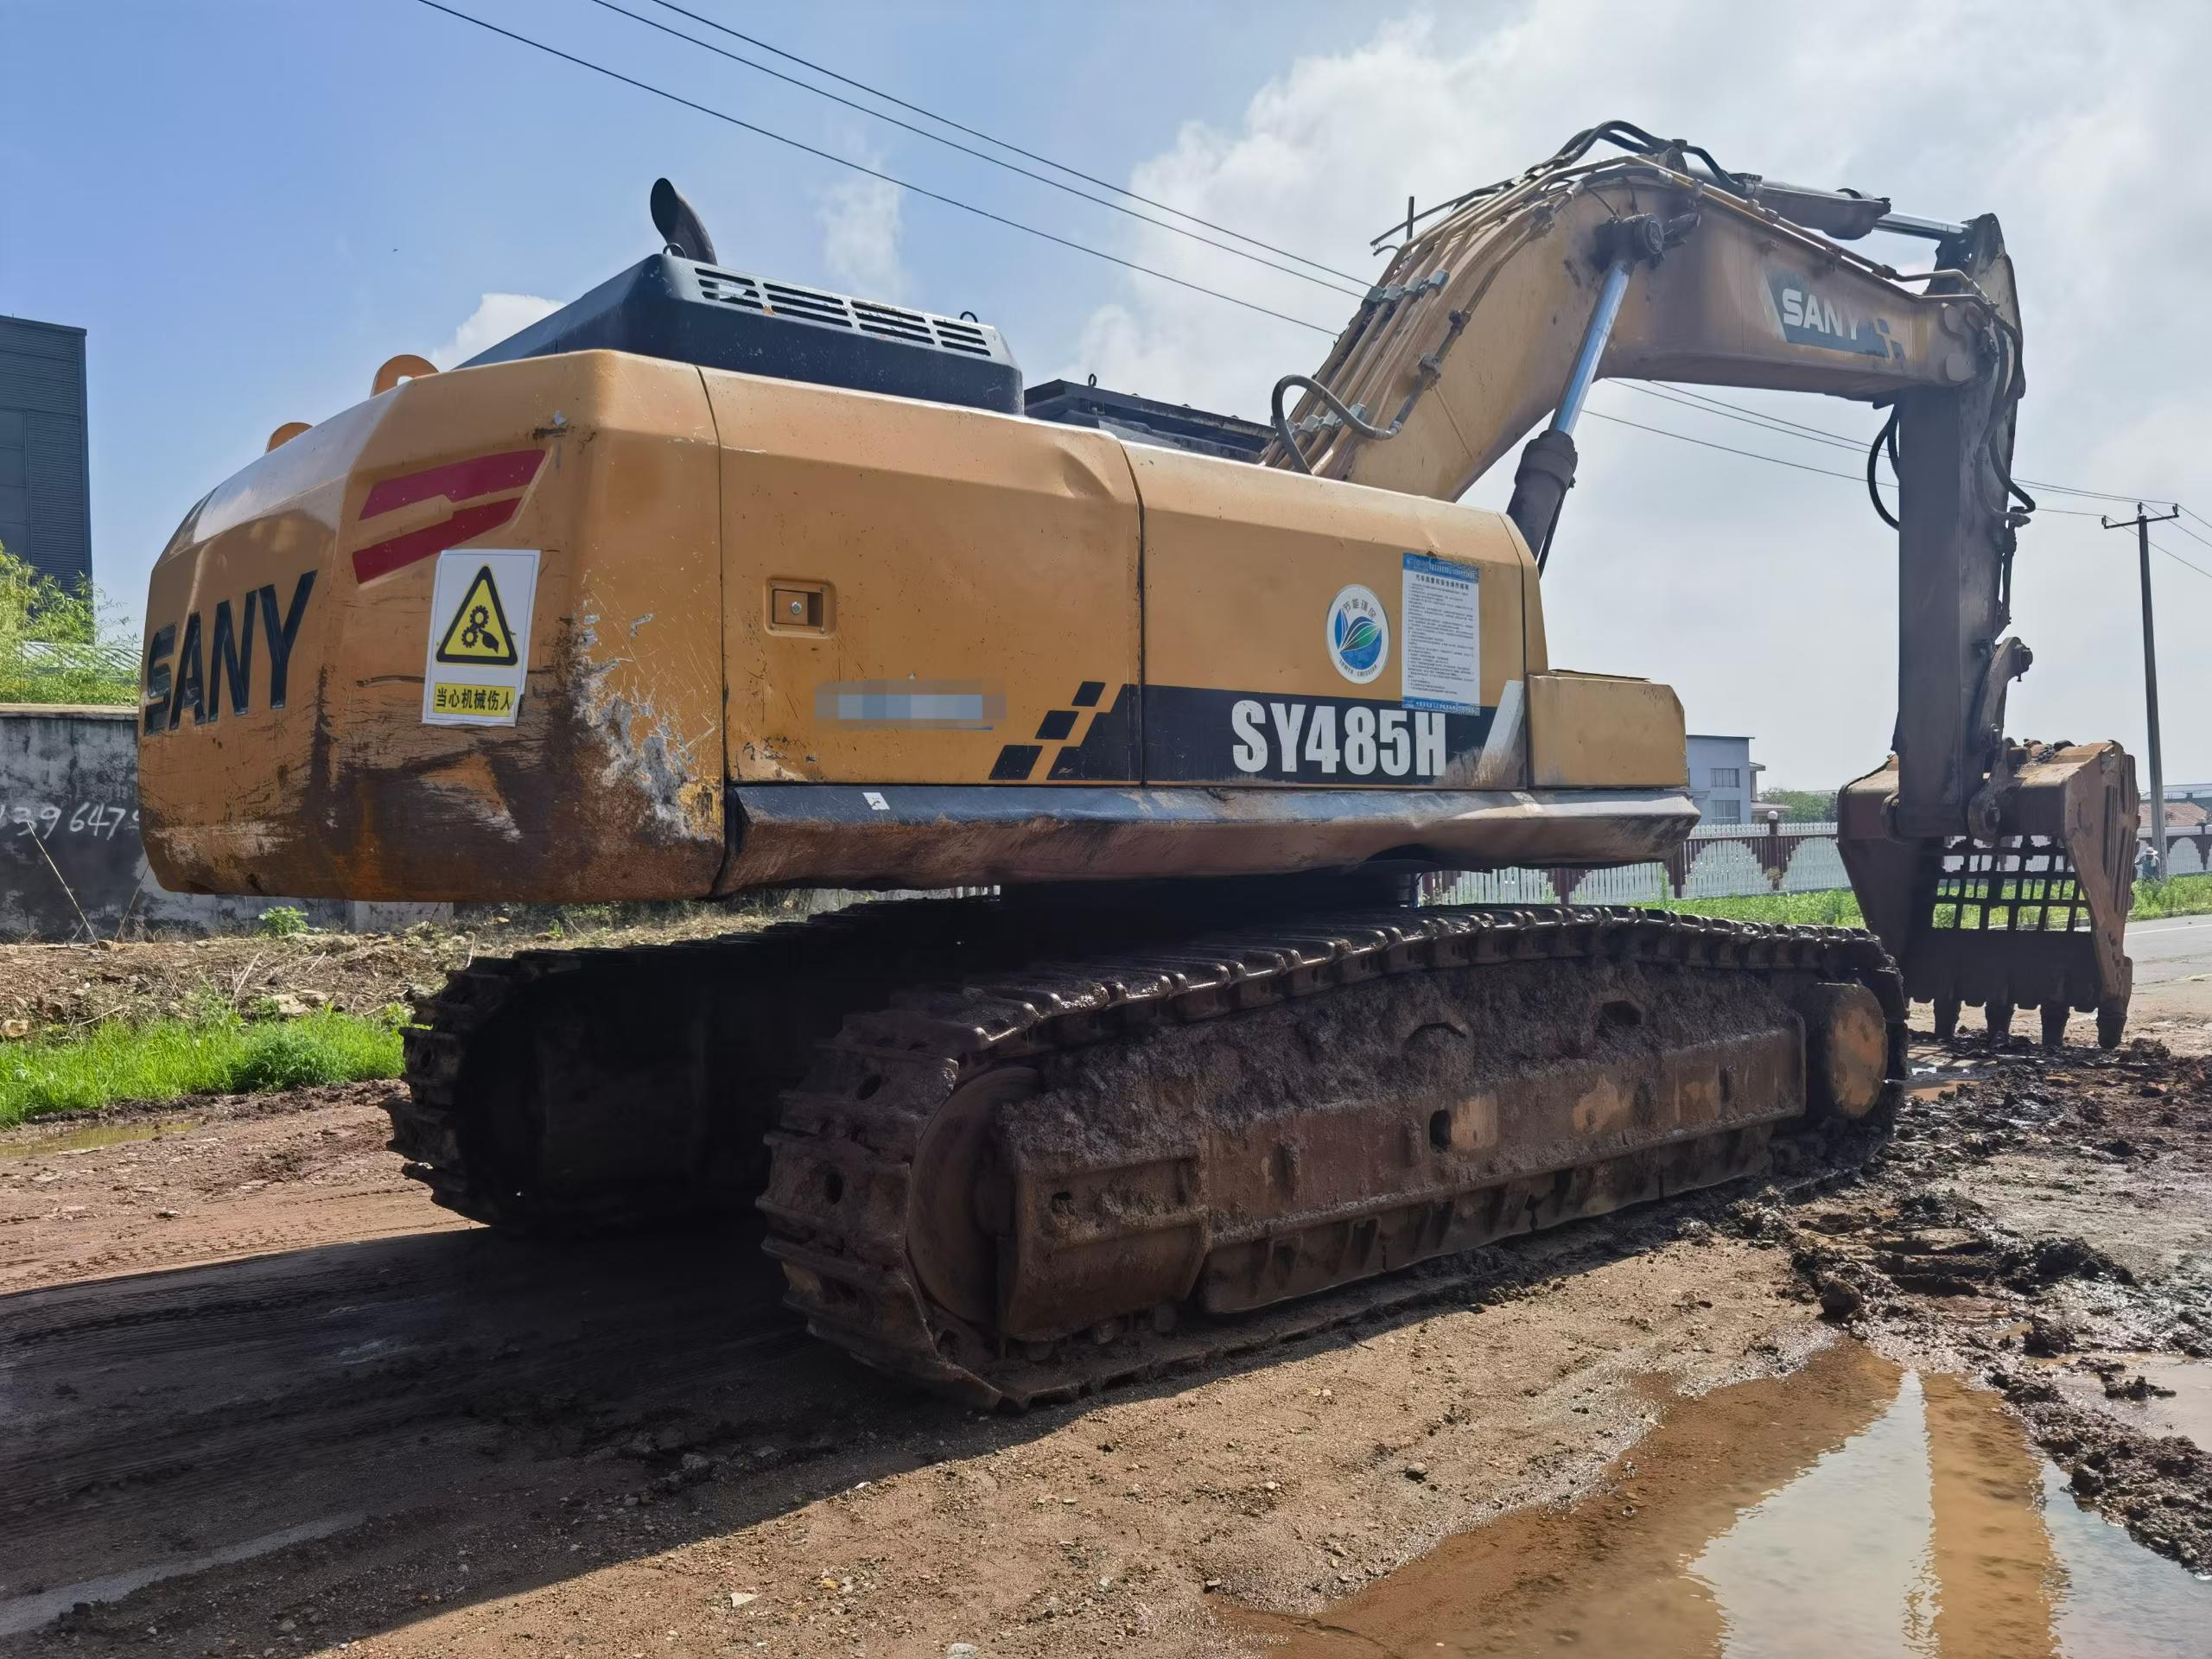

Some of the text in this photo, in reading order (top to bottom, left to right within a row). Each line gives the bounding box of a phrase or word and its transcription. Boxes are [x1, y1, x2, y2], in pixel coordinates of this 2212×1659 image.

[1782, 288, 1860, 340] SANY
[143, 569, 318, 736] SANY
[435, 687, 512, 711] 当心机械伤人
[1231, 700, 1446, 776] SY485H
